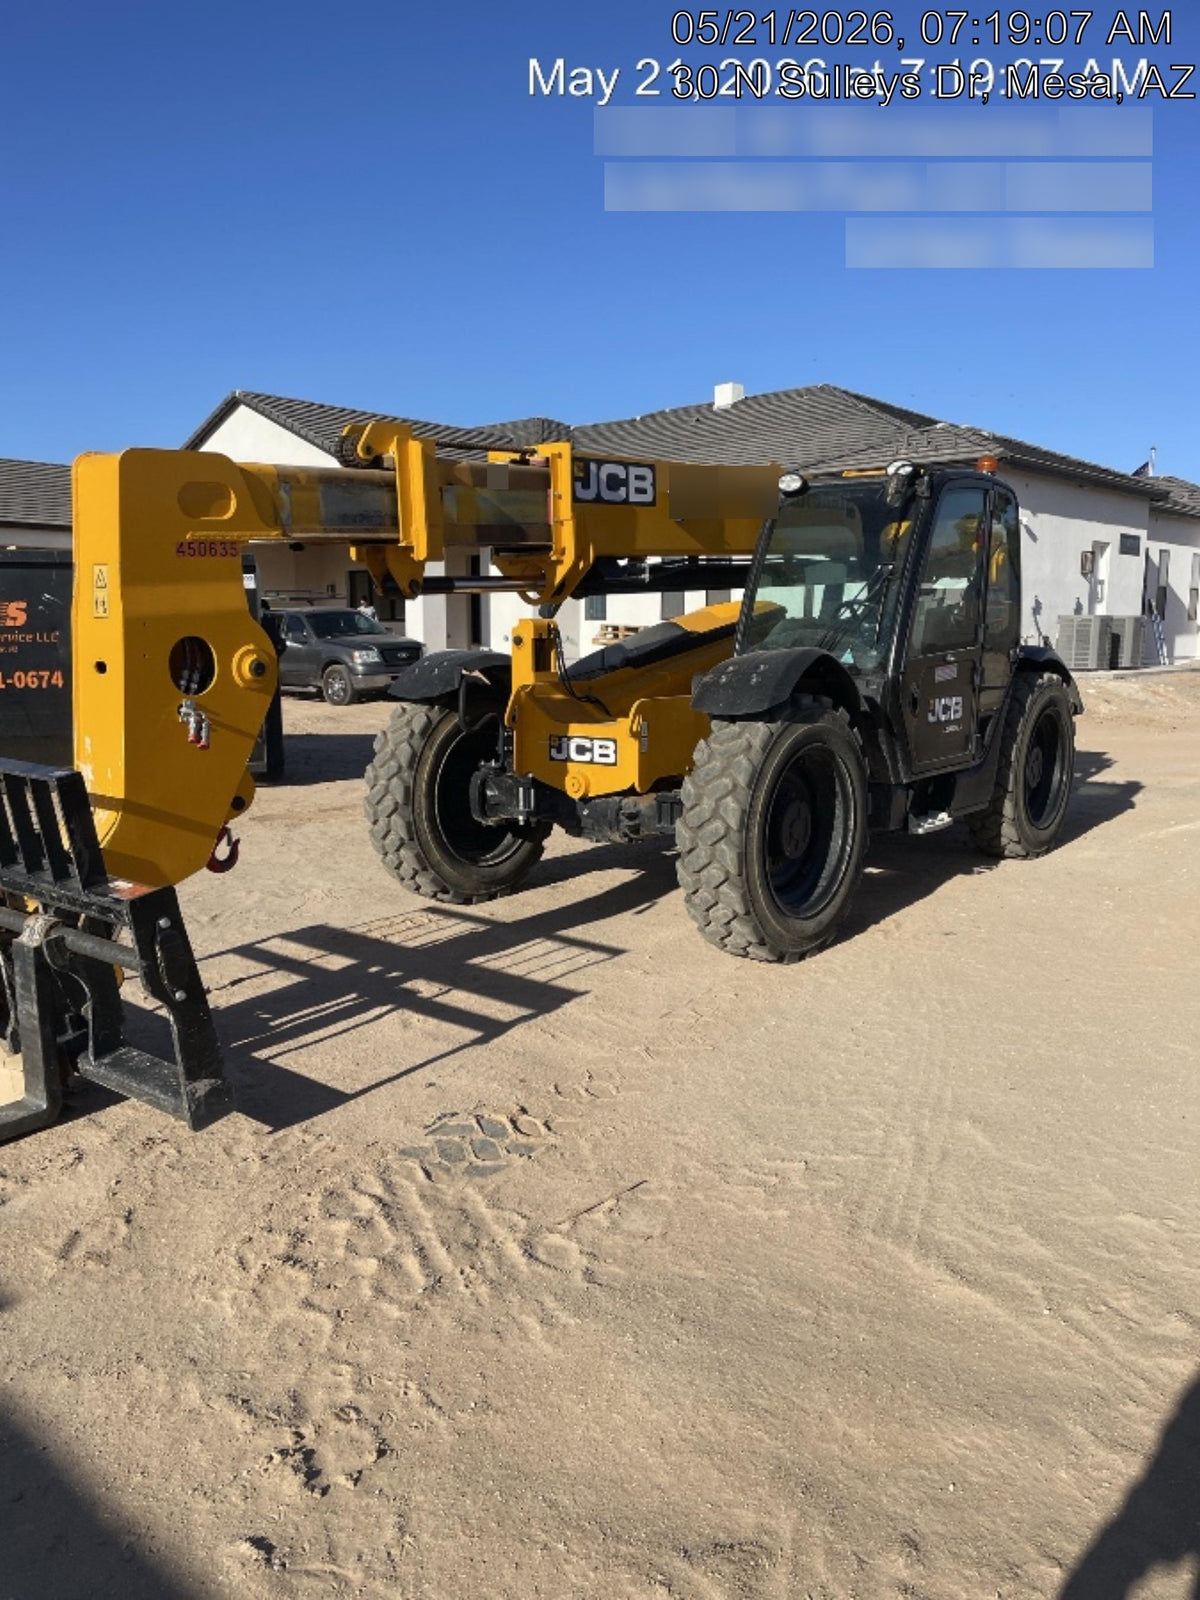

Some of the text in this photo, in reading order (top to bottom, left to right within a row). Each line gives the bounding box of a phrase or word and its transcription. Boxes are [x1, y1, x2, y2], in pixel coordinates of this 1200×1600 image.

[574, 461, 654, 502] JCB
[176, 541, 240, 558] 450635
[36, 631, 60, 643] LLC
[928, 696, 963, 723] JCB
[550, 737, 616, 763] JCB
